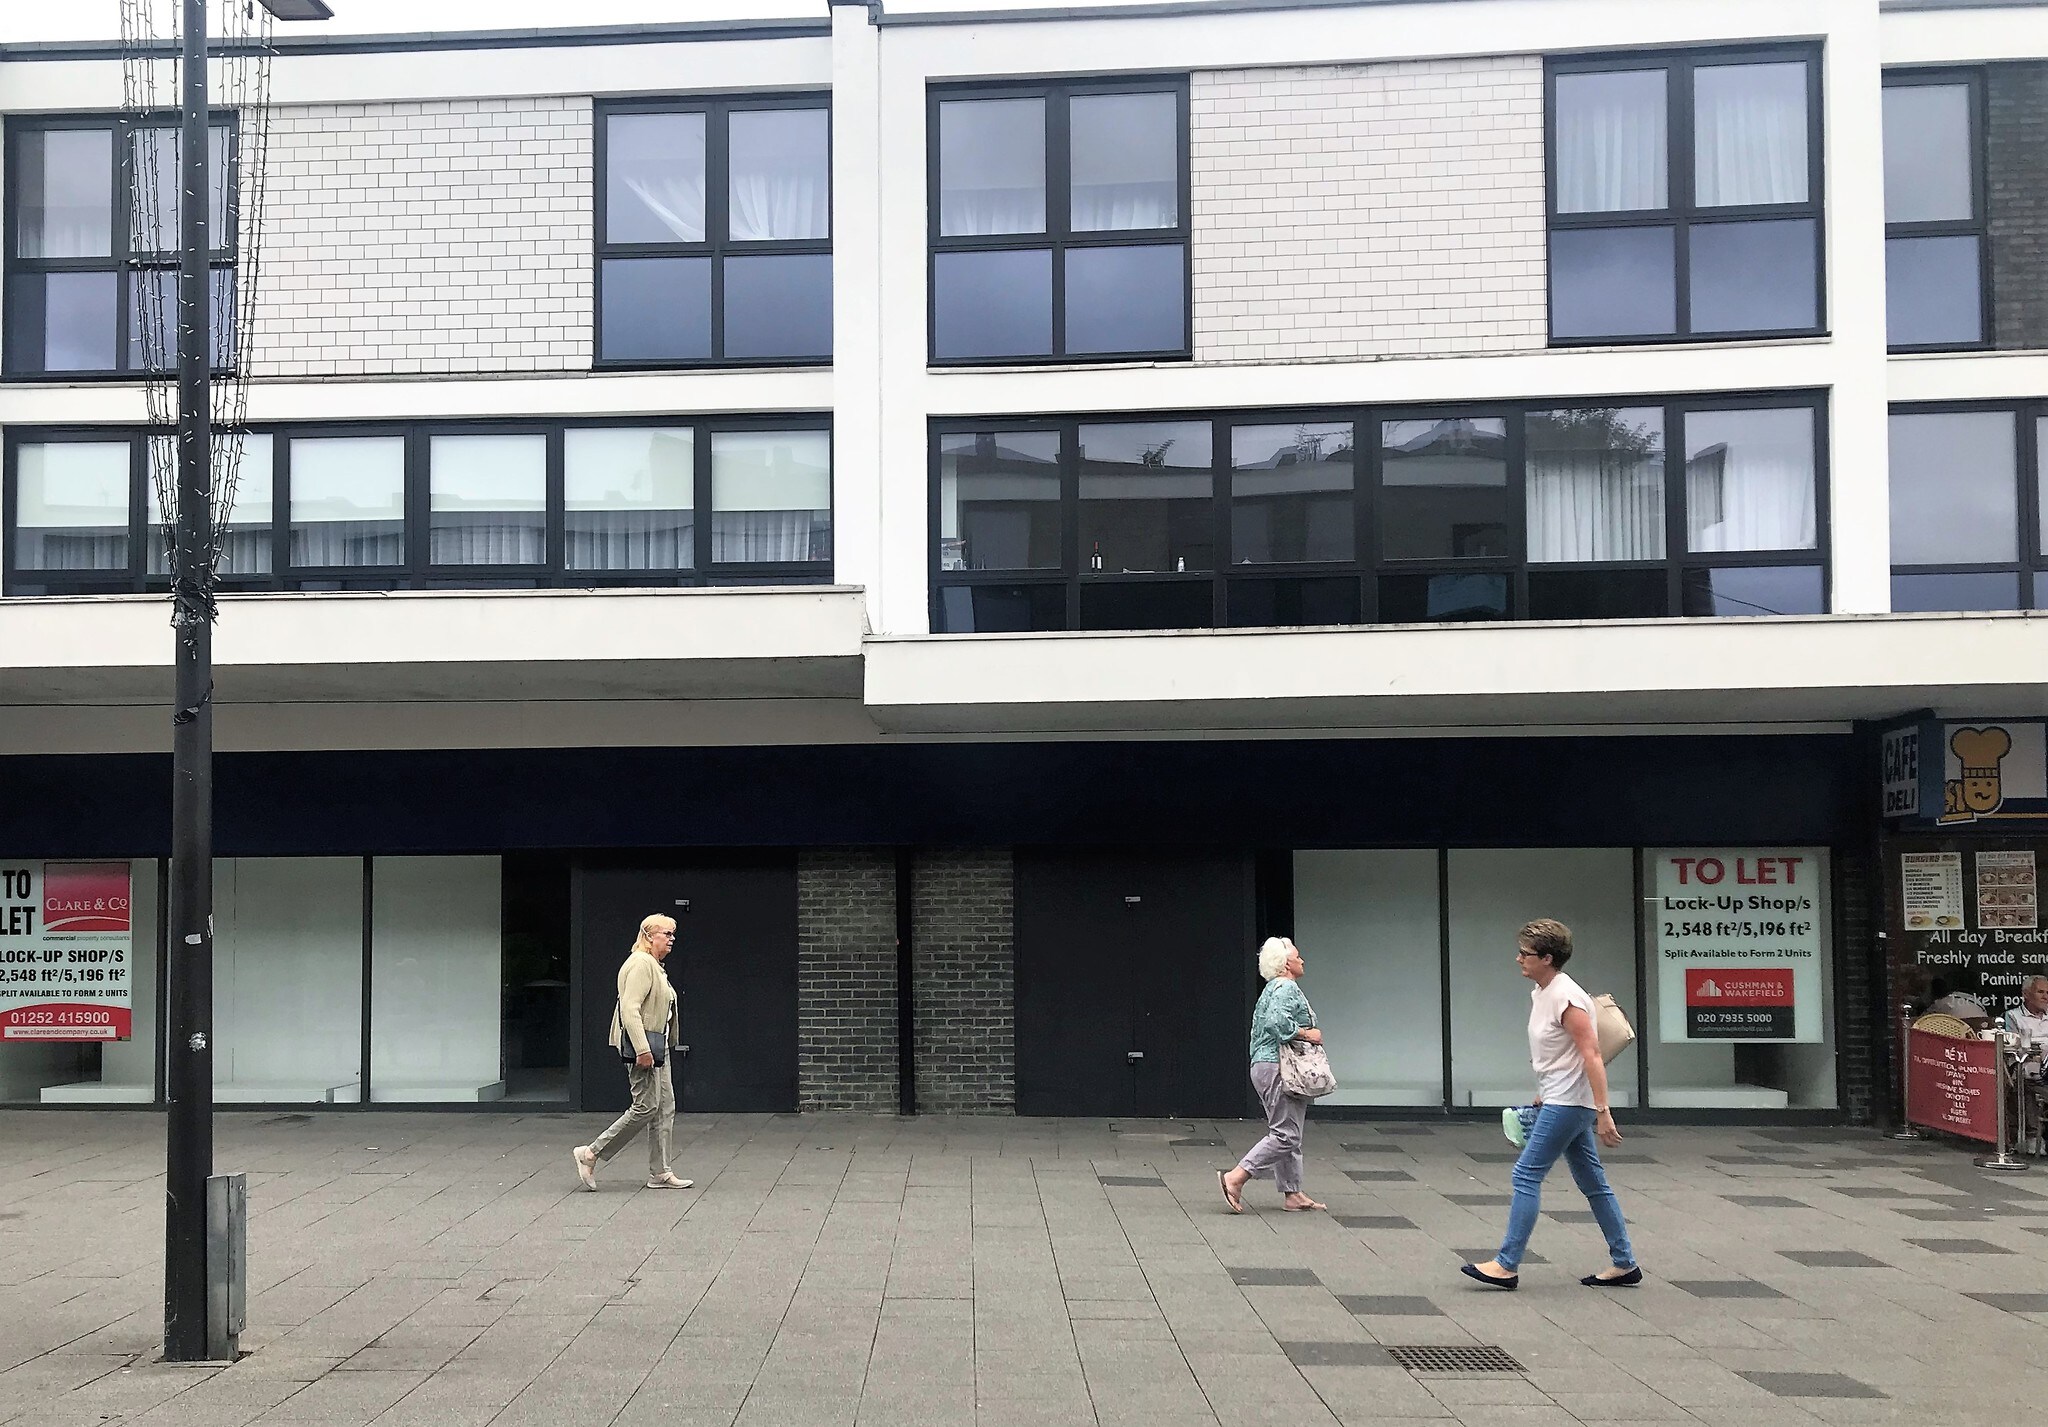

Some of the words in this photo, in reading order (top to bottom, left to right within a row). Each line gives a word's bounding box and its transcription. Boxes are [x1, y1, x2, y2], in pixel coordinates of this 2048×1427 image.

[1886, 788, 1915, 812] DELI
[1670, 857, 1726, 885] TO
[1736, 857, 1804, 885] LET
[2, 869, 32, 900] TO
[46, 897, 91, 911] CLARE
[94, 897, 106, 911] &
[1665, 895, 1744, 914] Lock-Up
[1748, 895, 1811, 914] Shop/s
[1665, 921, 1713, 939] 2,548
[1929, 929, 1951, 943] All
[1957, 929, 1987, 947] day
[0, 950, 63, 963] LOCK-UP
[68, 950, 124, 964] SHOP/S
[1665, 949, 1688, 959] Split
[1690, 949, 1736, 958] Available
[1738, 950, 1748, 958] to
[1750, 949, 1776, 958] Form
[1777, 949, 1783, 958] 2
[1785, 949, 1812, 958] Units
[1917, 950, 1971, 968] Freshly
[1978, 949, 2016, 965] made
[0, 969, 37, 984] 2,548
[1724, 981, 1774, 989] CUSHMAN
[1777, 981, 1784, 989] &
[0, 989, 17, 997] PLIT
[19, 989, 60, 997] AVAILABLE
[62, 989, 72, 997] TO
[74, 989, 96, 997] FORM
[98, 989, 103, 997] 2
[105, 989, 128, 997] UNITS
[1724, 989, 1784, 997] WAKEFIELD
[10, 1012, 54, 1024] 01252
[57, 1012, 110, 1024] 415900
[1697, 1013, 1717, 1023] 020
[1719, 1013, 1744, 1023] 7935
[1747, 1013, 1773, 1023] 5000
[13, 1028, 108, 1037] www.clareandcompany.co.uk
